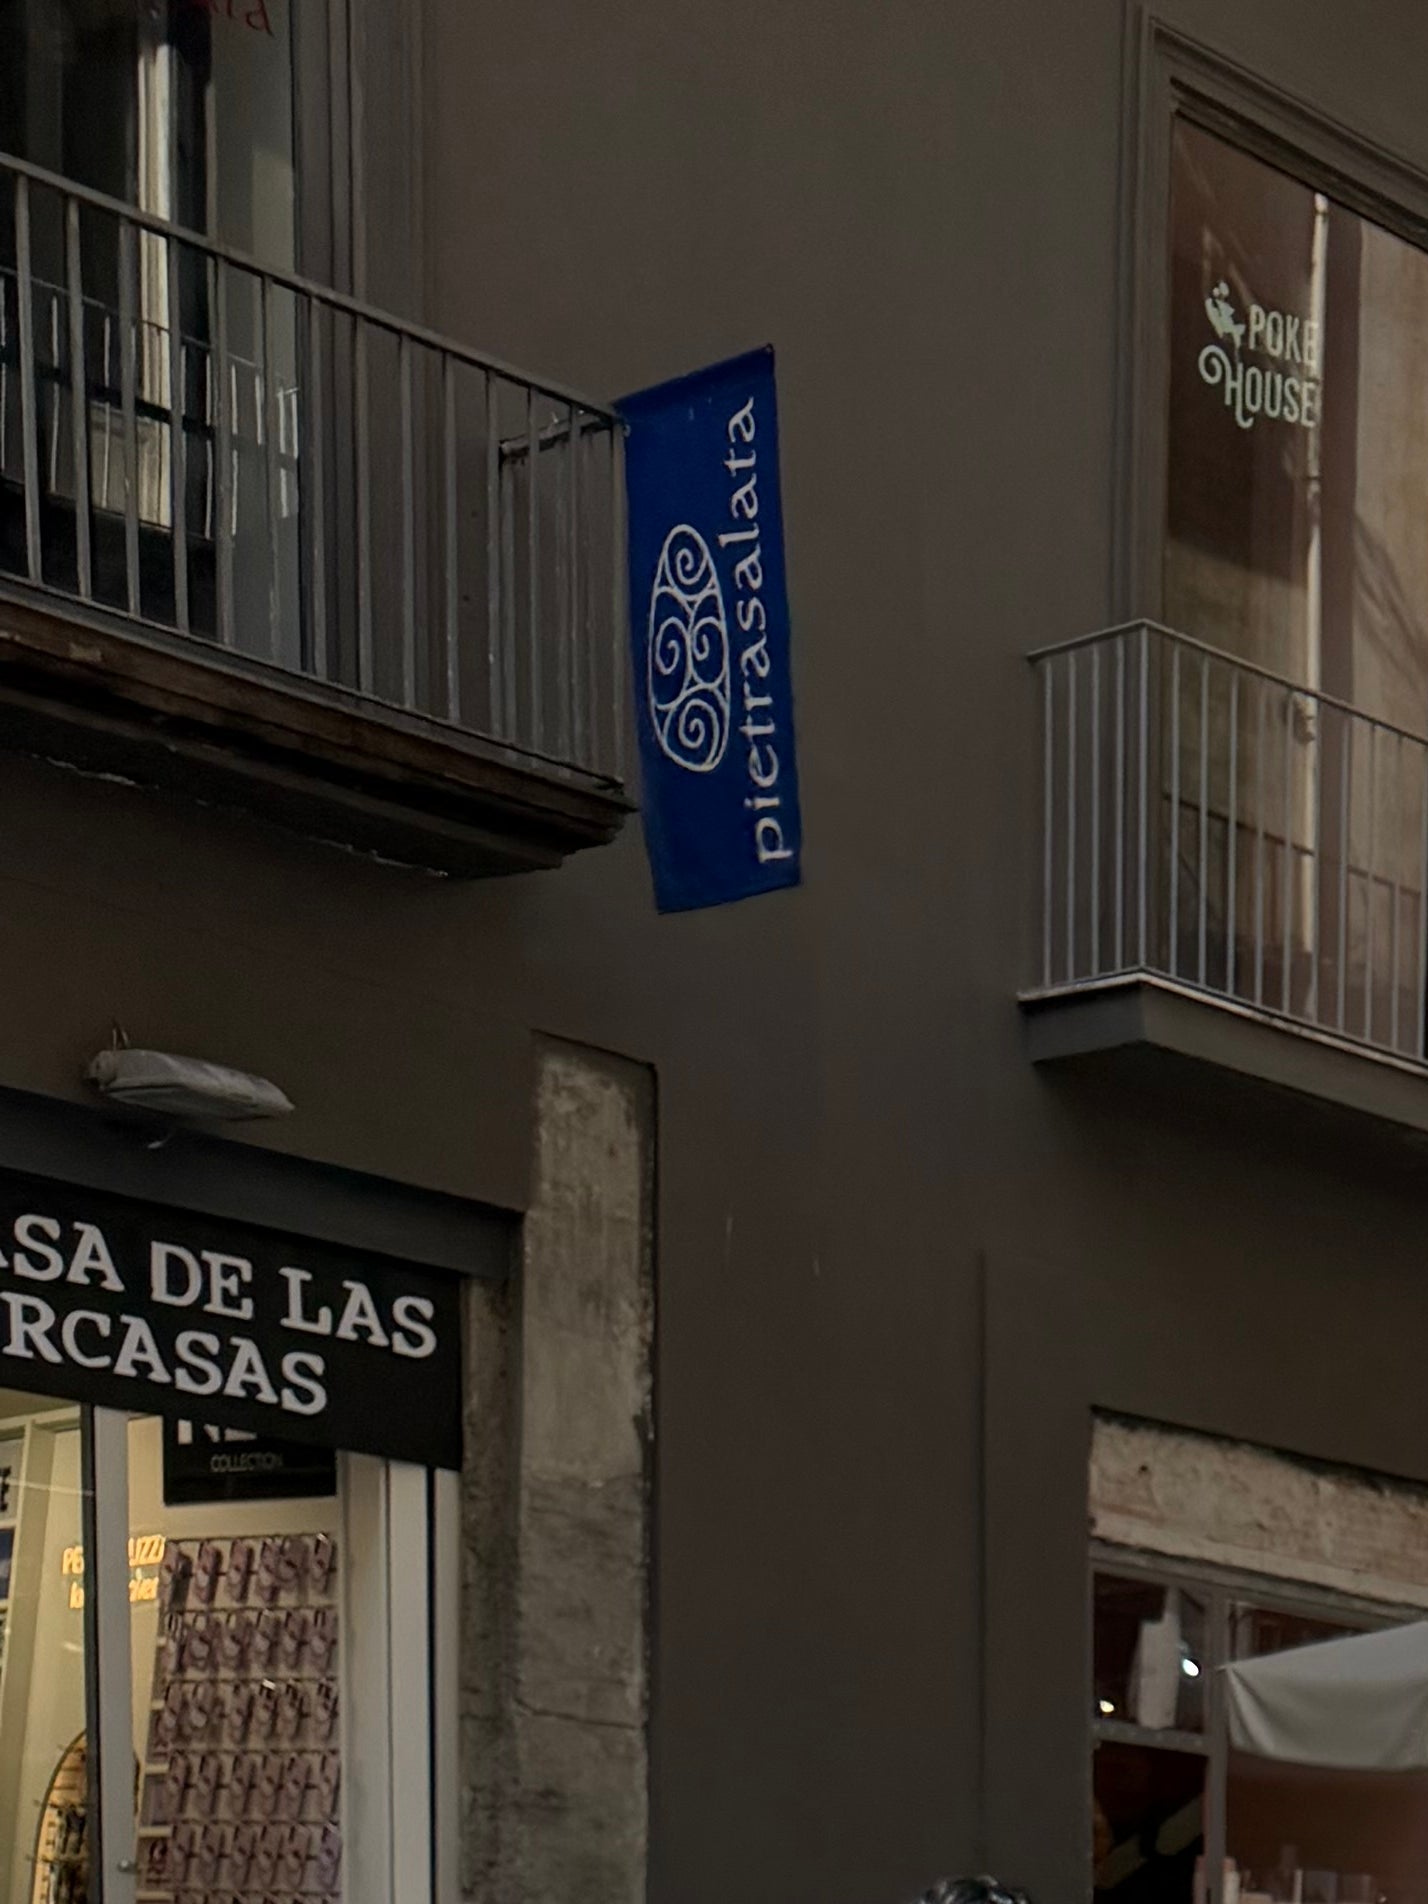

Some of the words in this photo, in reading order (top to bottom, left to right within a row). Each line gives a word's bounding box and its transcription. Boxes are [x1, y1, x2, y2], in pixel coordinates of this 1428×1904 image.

[1198, 344, 1317, 429] HOUSE
[1249, 303, 1318, 367] POKE
[716, 397, 793, 866] pietrasalata
[0, 1214, 125, 1292] SA
[150, 1240, 254, 1320] DE
[278, 1266, 437, 1359] LAS
